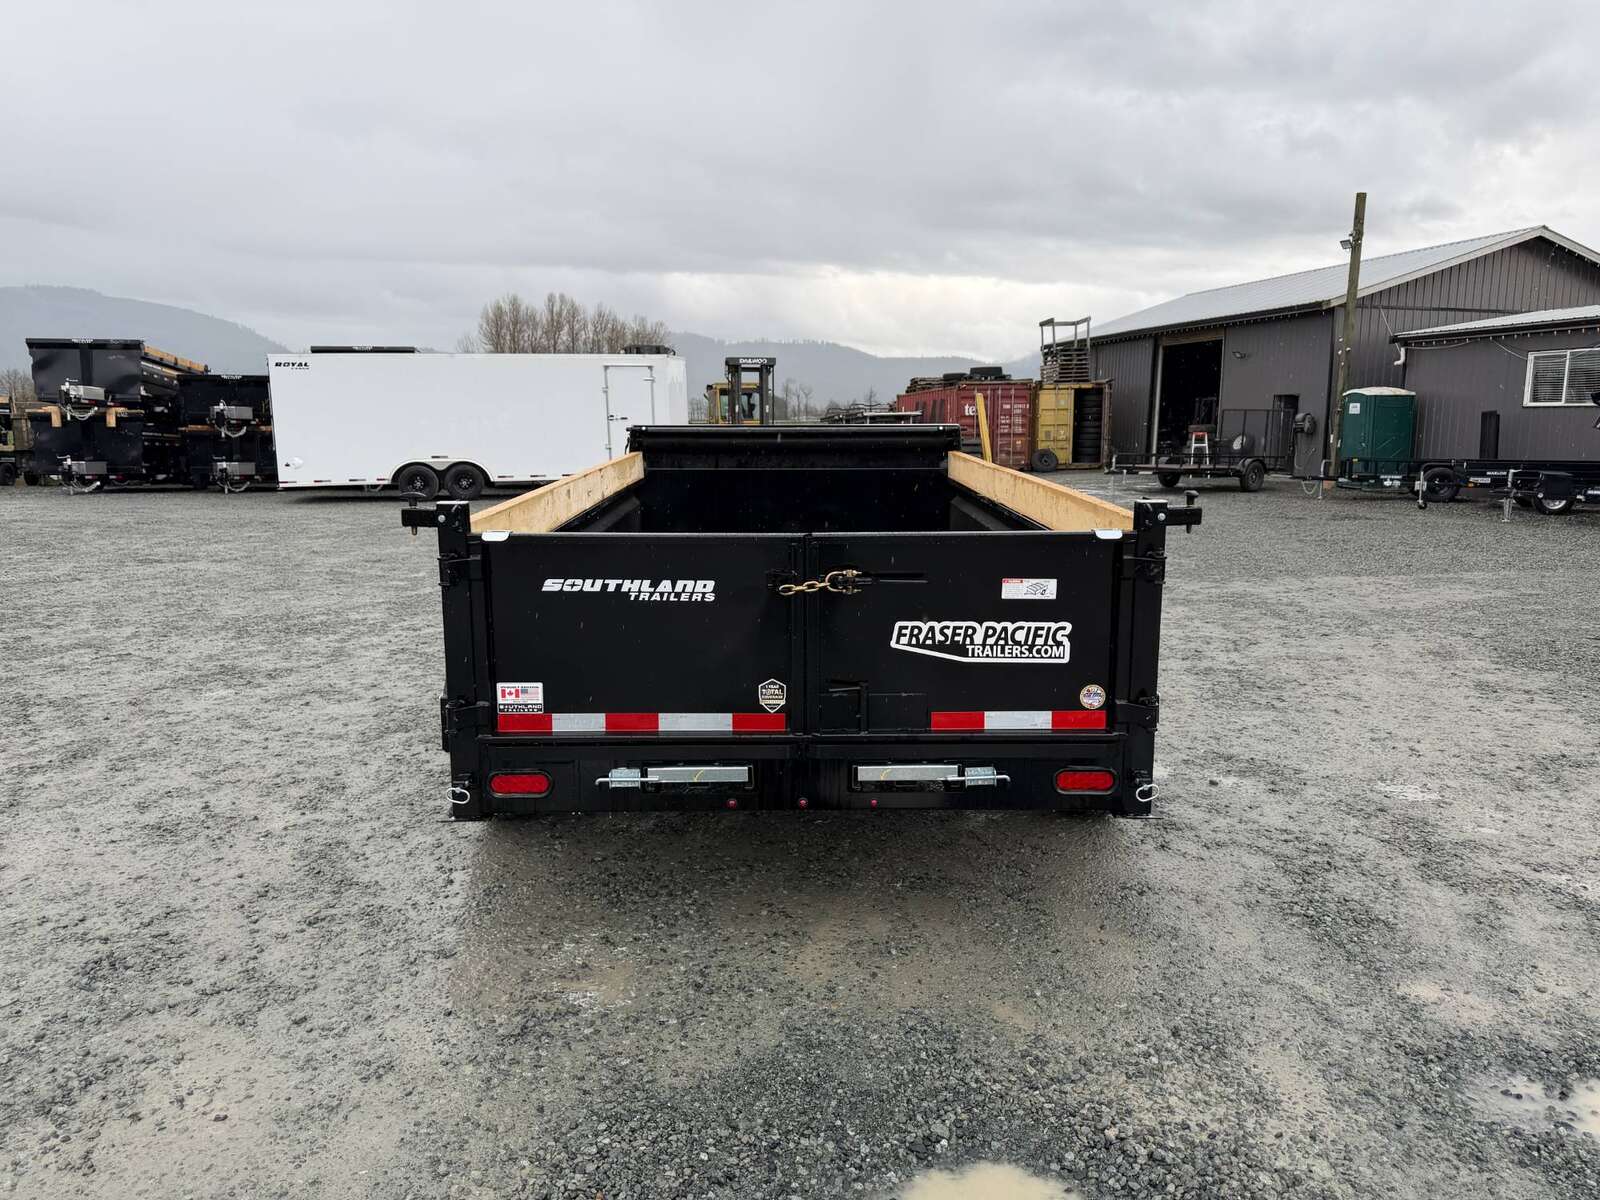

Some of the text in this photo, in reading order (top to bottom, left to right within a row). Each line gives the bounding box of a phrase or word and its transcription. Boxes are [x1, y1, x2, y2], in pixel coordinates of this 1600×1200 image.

[964, 403, 977, 416] te
[541, 578, 716, 593] SOUTHLAND
[629, 592, 716, 602] TRAILERS
[895, 625, 1067, 645] FRASER PACIFIC
[966, 645, 1064, 658] TRAILERS.COM
